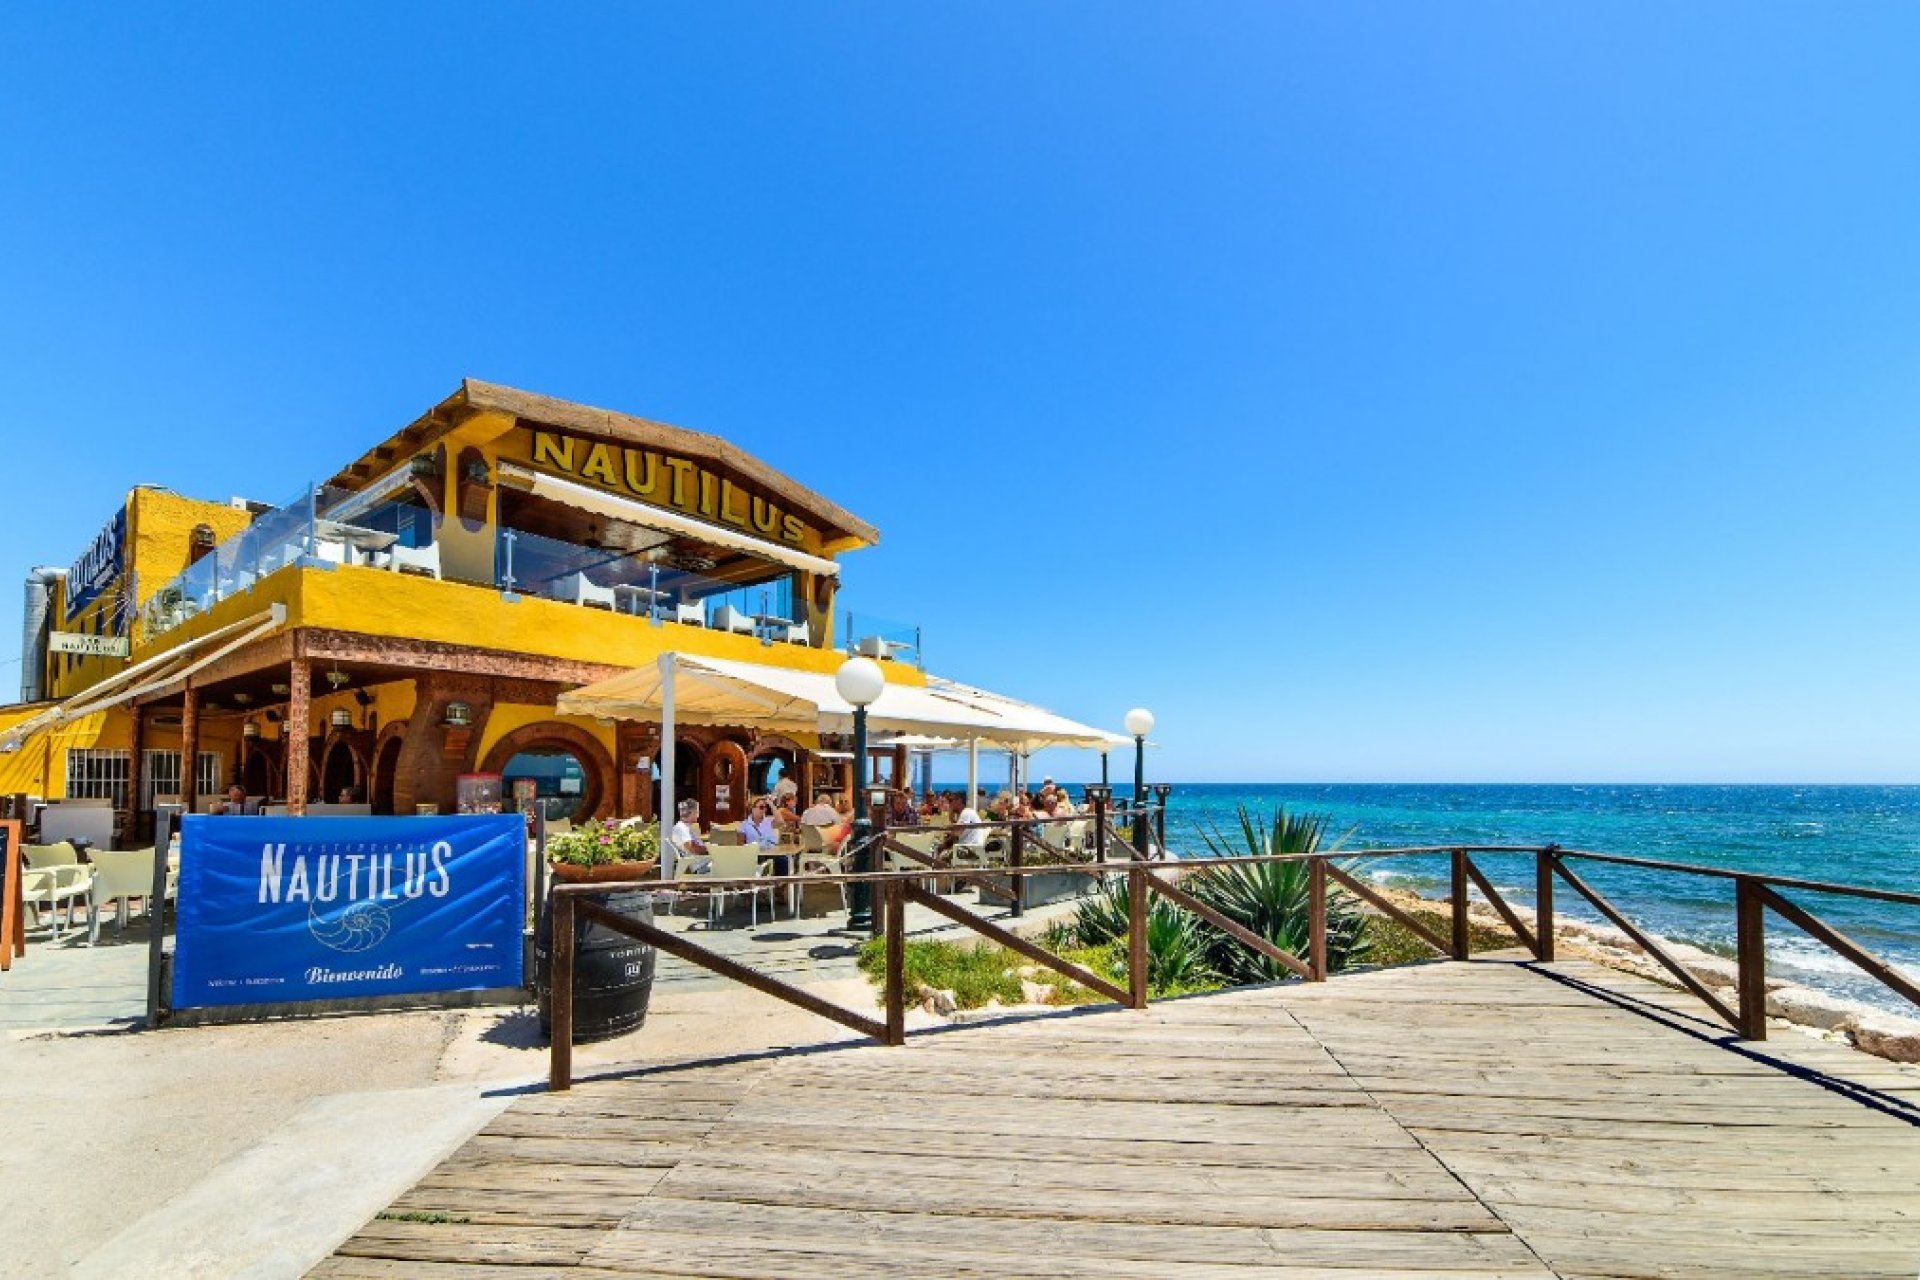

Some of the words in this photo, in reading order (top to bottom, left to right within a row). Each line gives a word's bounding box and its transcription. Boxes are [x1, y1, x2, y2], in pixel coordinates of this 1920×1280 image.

[534, 431, 805, 542] NAUTILUS
[258, 841, 452, 903] NAUTILUS
[304, 963, 404, 985] Bienvenido
